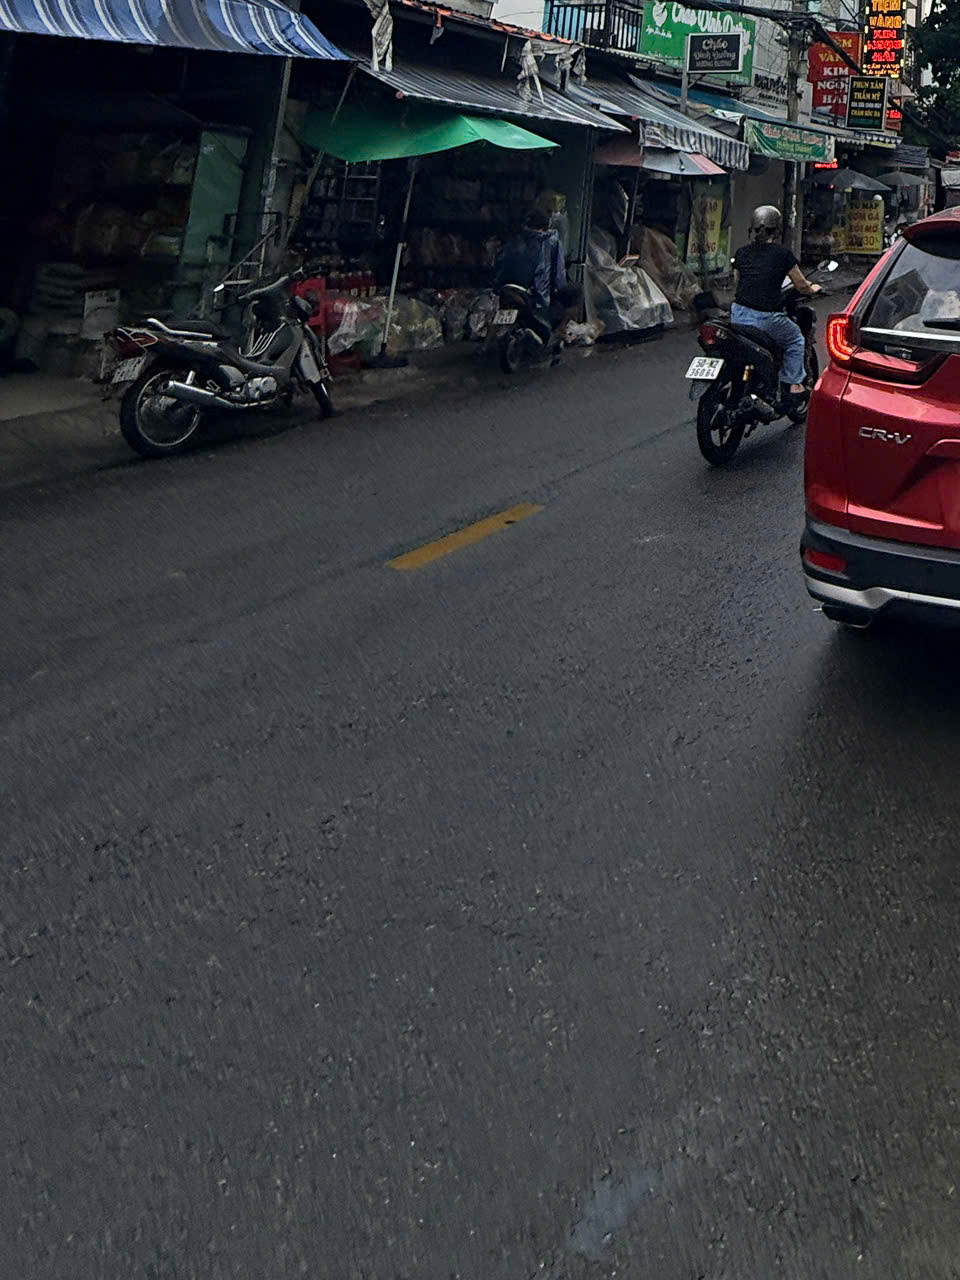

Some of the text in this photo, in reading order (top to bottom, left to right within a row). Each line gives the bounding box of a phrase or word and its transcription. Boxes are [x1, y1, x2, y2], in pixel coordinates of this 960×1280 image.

[869, 14, 902, 28] VÀNG
[824, 67, 849, 76] KIM
[859, 426, 912, 444] CR-V
